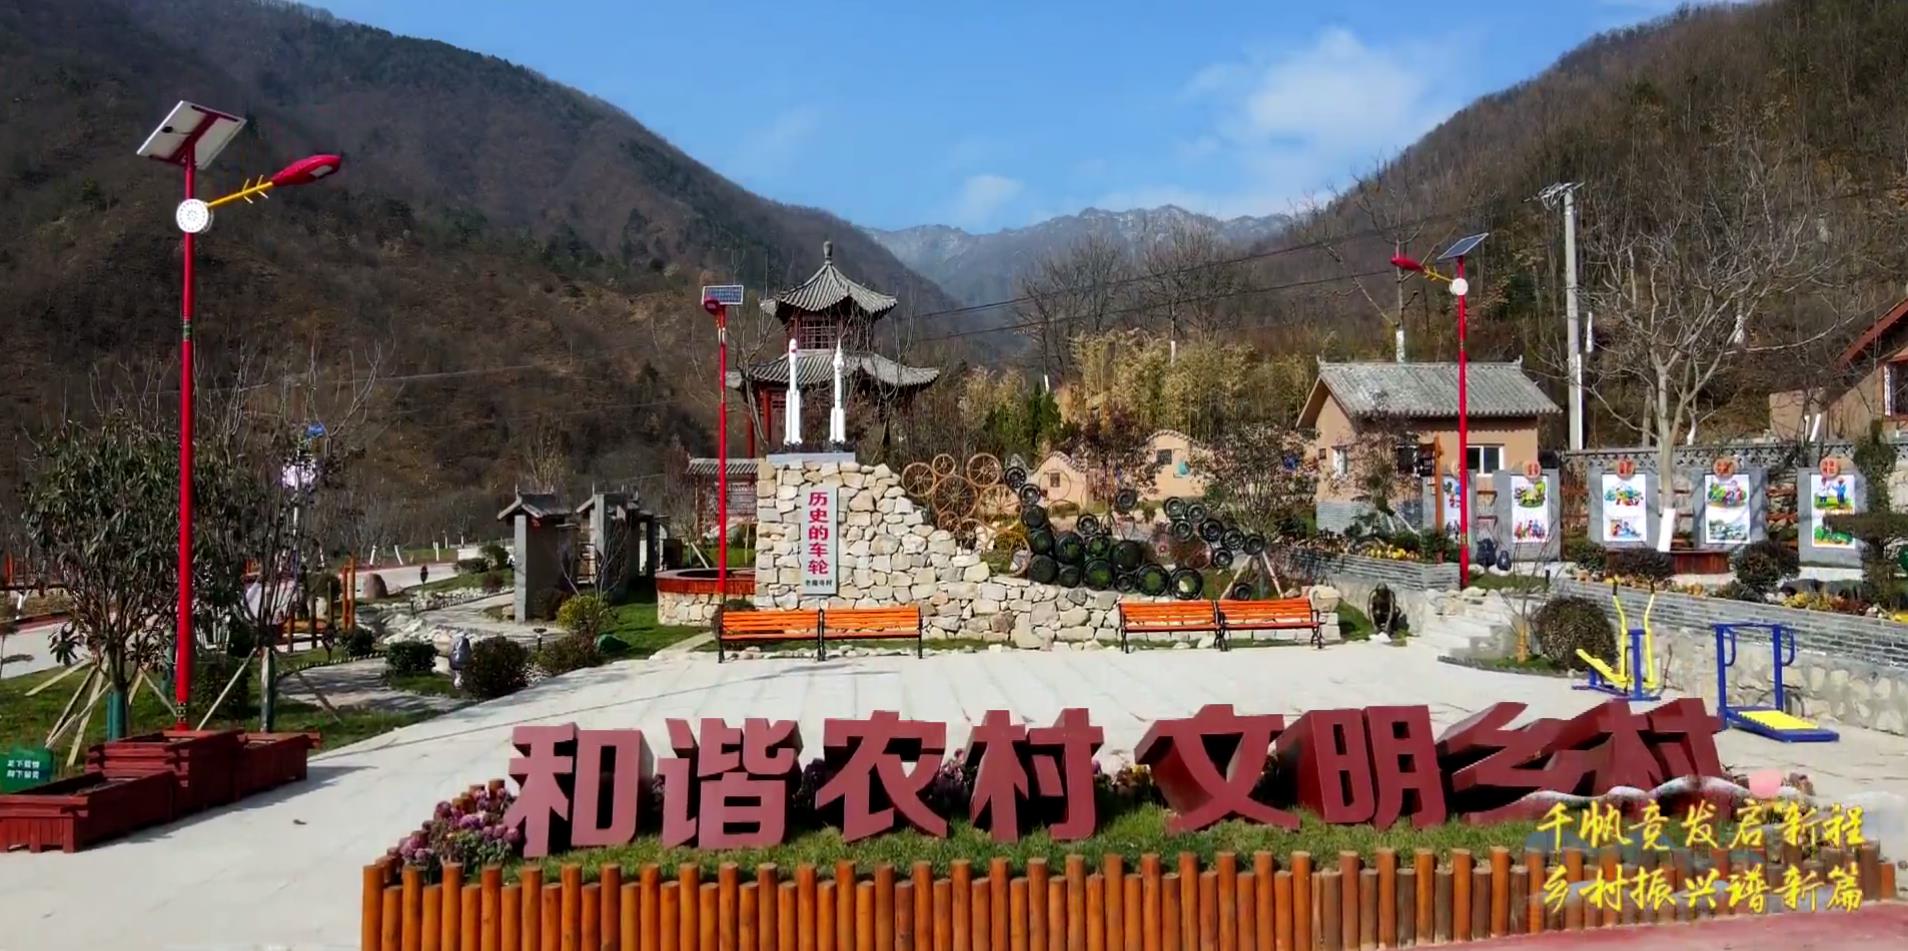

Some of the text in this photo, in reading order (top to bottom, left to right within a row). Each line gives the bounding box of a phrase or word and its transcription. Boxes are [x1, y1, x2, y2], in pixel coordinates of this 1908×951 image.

[808, 491, 830, 575] 历史的车轮
[504, 698, 1726, 858] 和谐农村文明乡村
